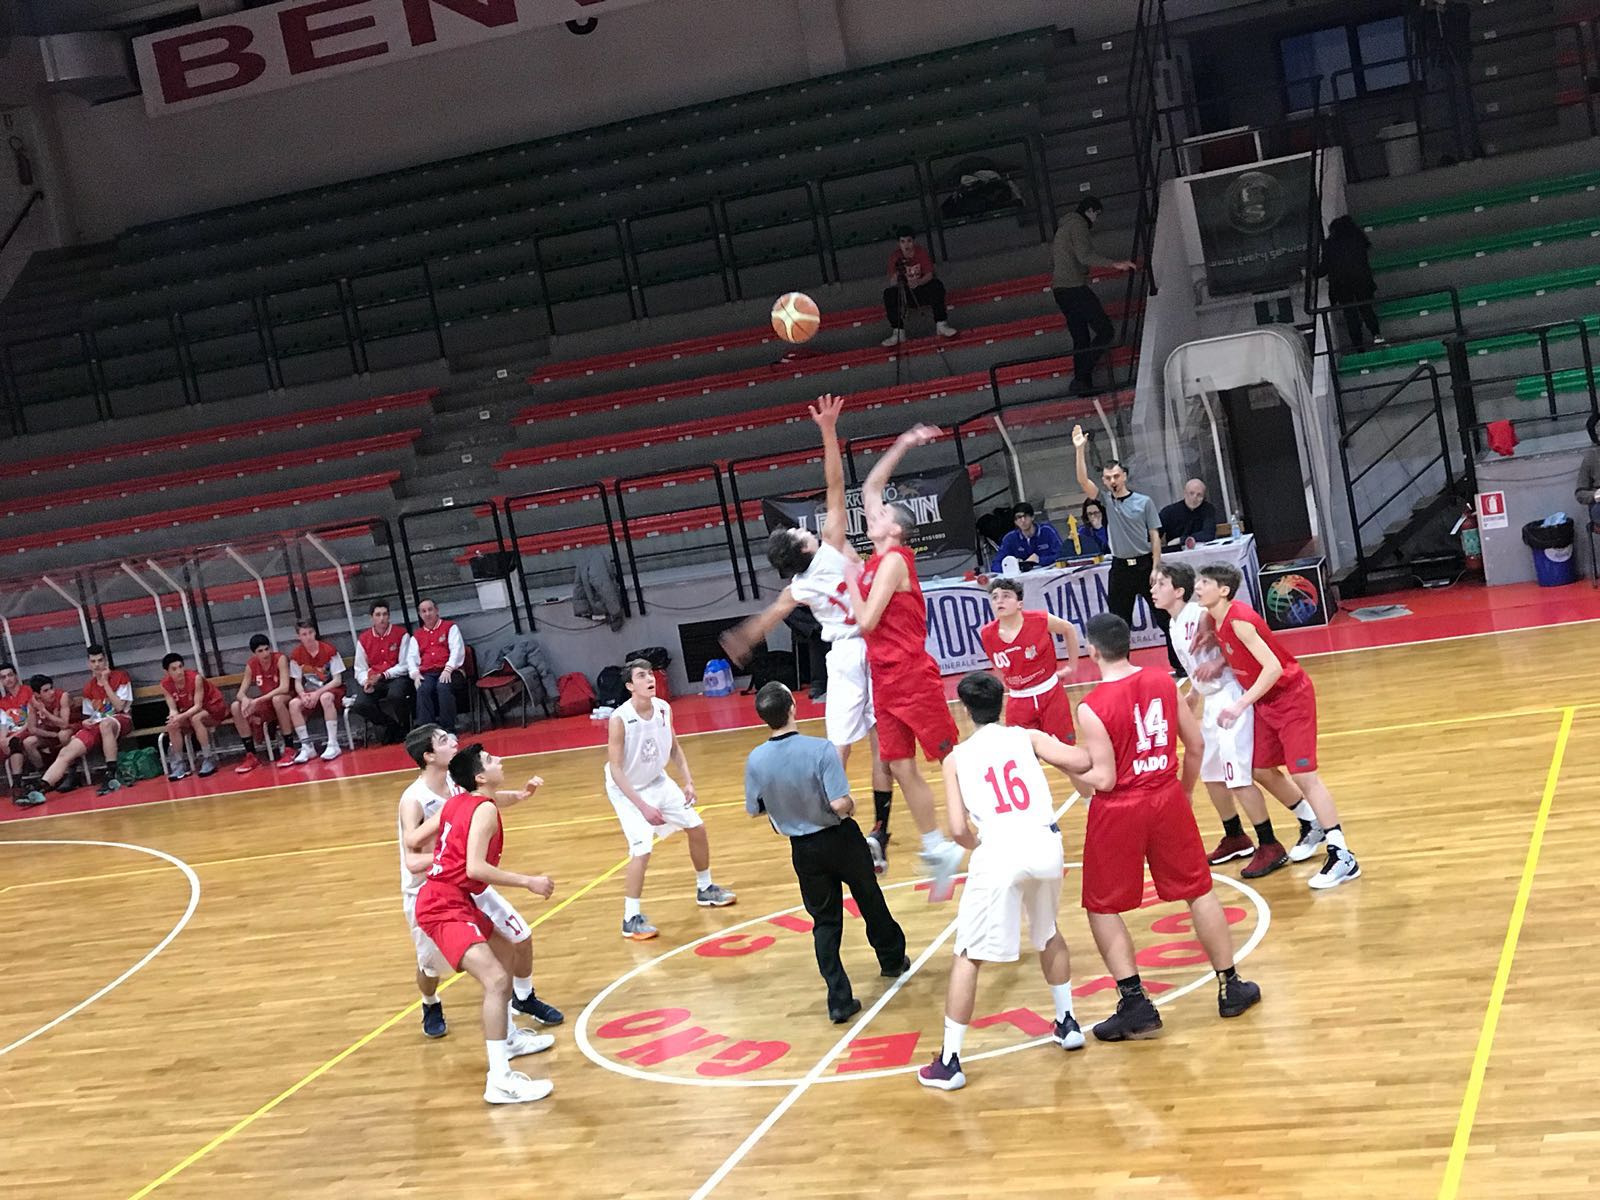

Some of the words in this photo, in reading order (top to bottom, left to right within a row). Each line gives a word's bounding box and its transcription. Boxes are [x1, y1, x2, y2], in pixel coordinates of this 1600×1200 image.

[152, 0, 598, 104] BEN
[1133, 697, 1169, 755] 14
[984, 760, 1030, 815] 16
[1132, 754, 1169, 776] VADO
[504, 914, 524, 937] 17
